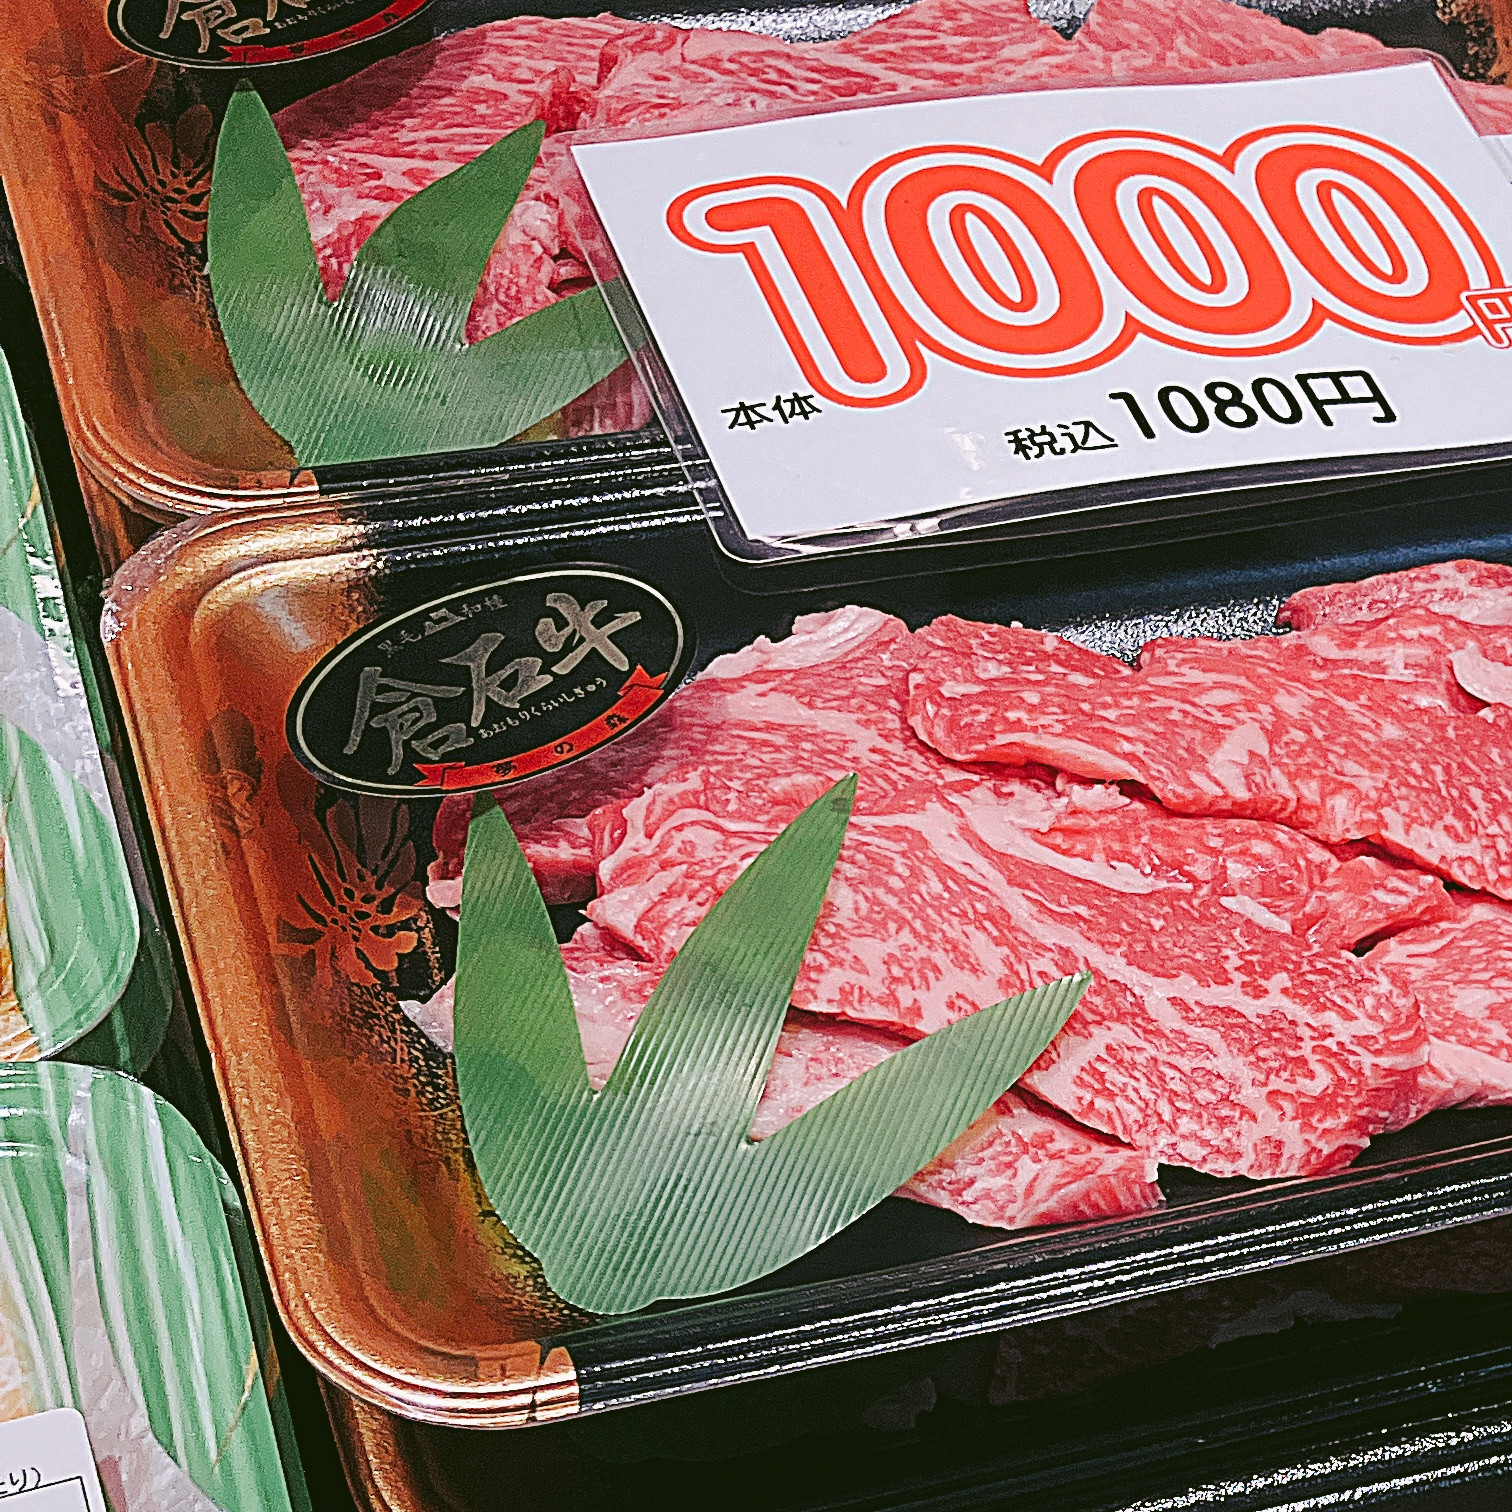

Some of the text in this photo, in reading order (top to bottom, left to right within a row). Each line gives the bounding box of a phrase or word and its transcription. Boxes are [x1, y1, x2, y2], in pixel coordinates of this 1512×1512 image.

[720, 391, 823, 432] 本体
[341, 592, 643, 776] 倉石牛
